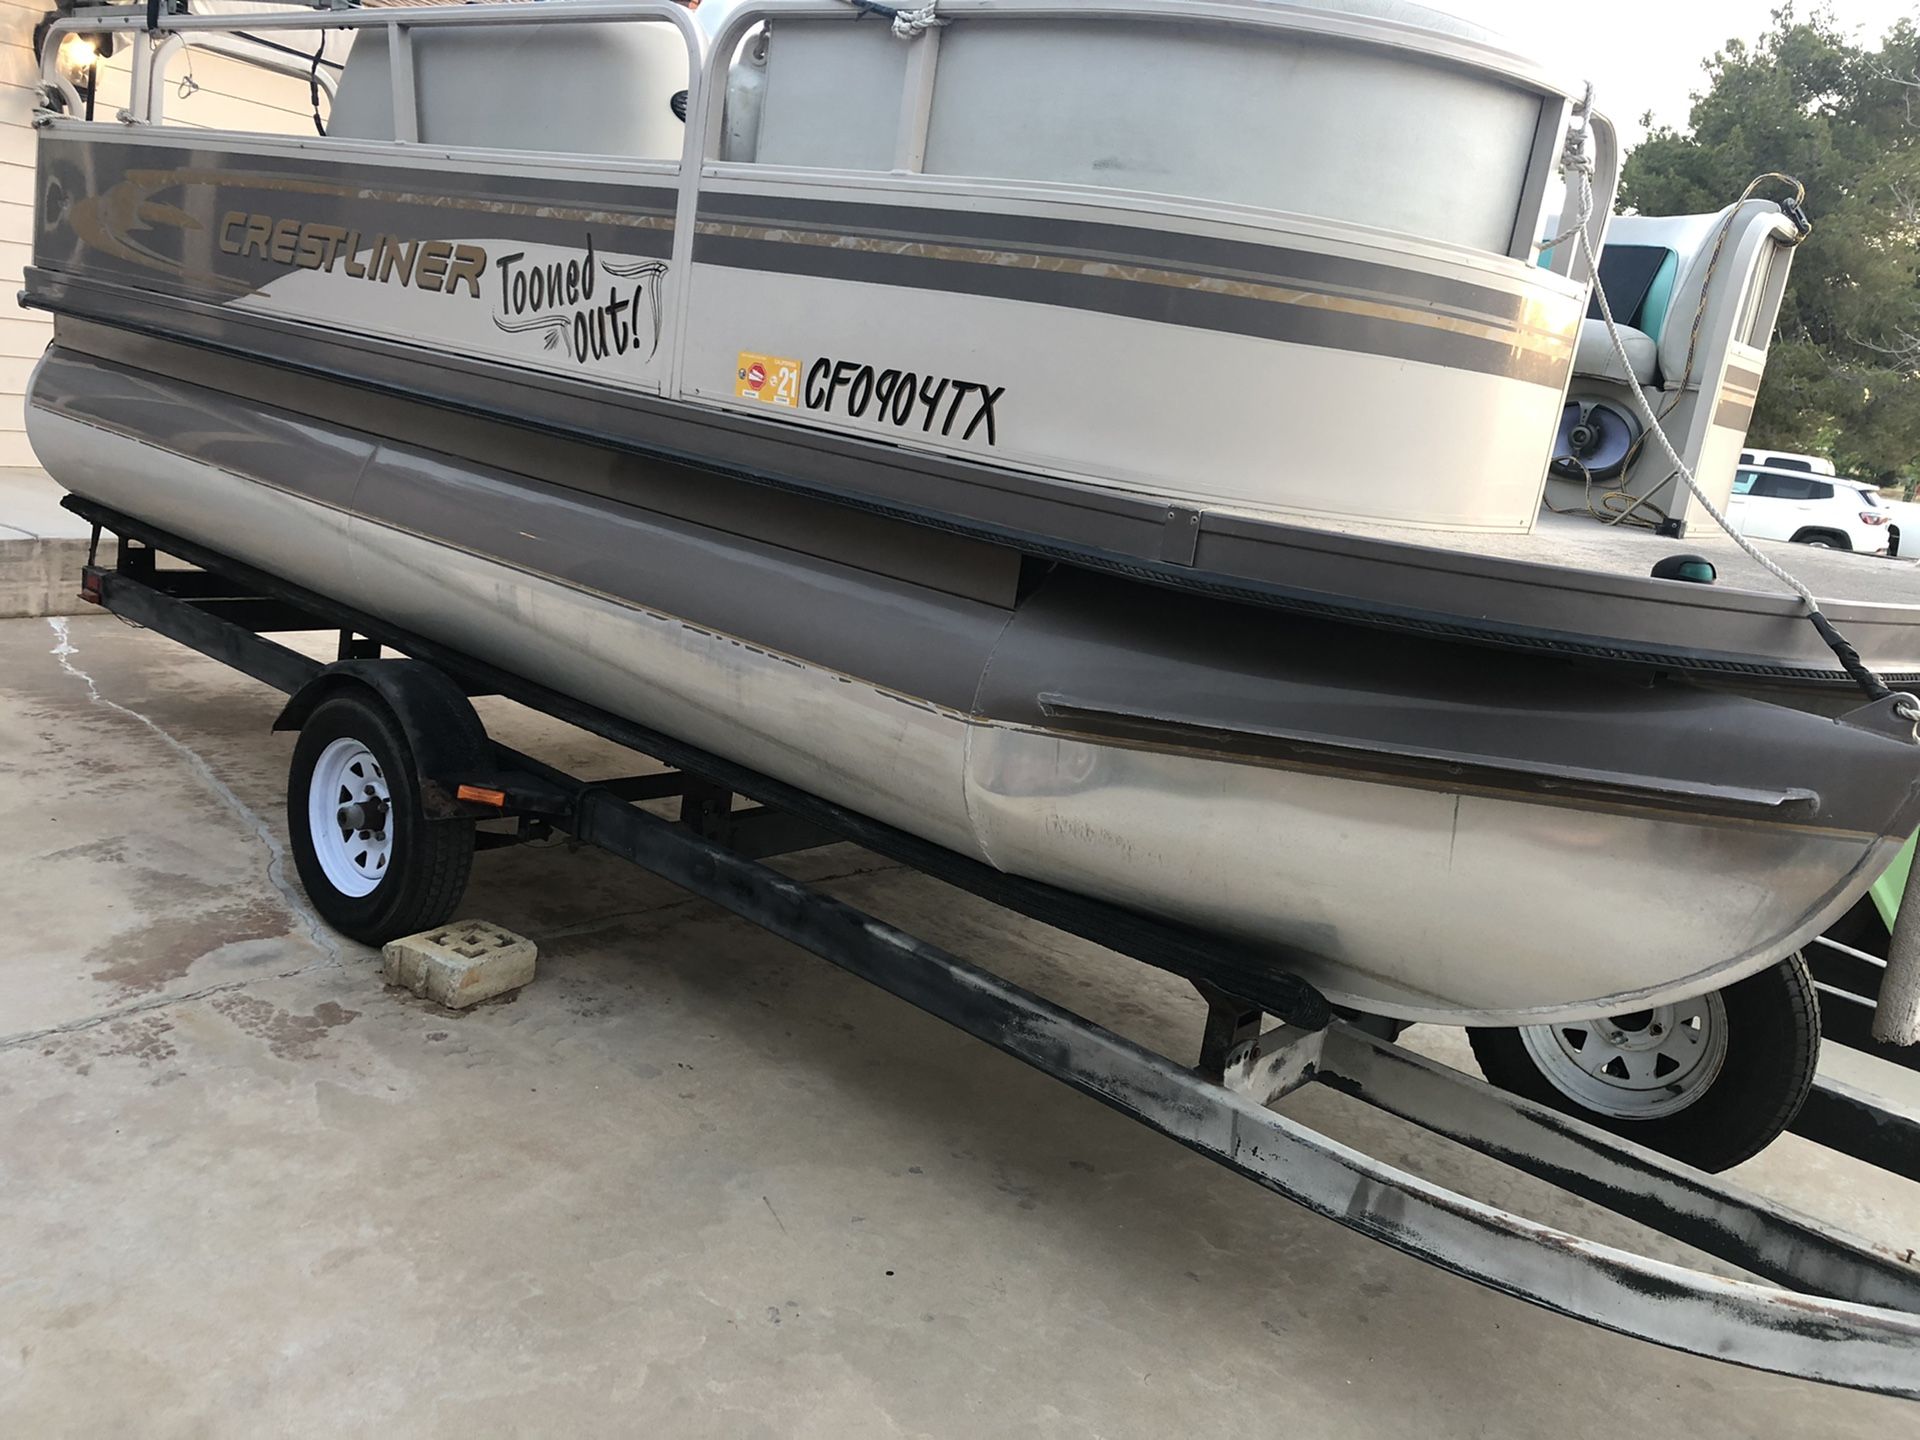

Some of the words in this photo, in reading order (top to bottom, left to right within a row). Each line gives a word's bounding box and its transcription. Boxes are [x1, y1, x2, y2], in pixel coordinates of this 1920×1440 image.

[218, 211, 488, 299] CRESTLINER
[497, 232, 595, 316] Tooned
[573, 284, 643, 364] out!
[777, 366, 798, 398] 21
[805, 357, 1006, 446] CF0904TX
